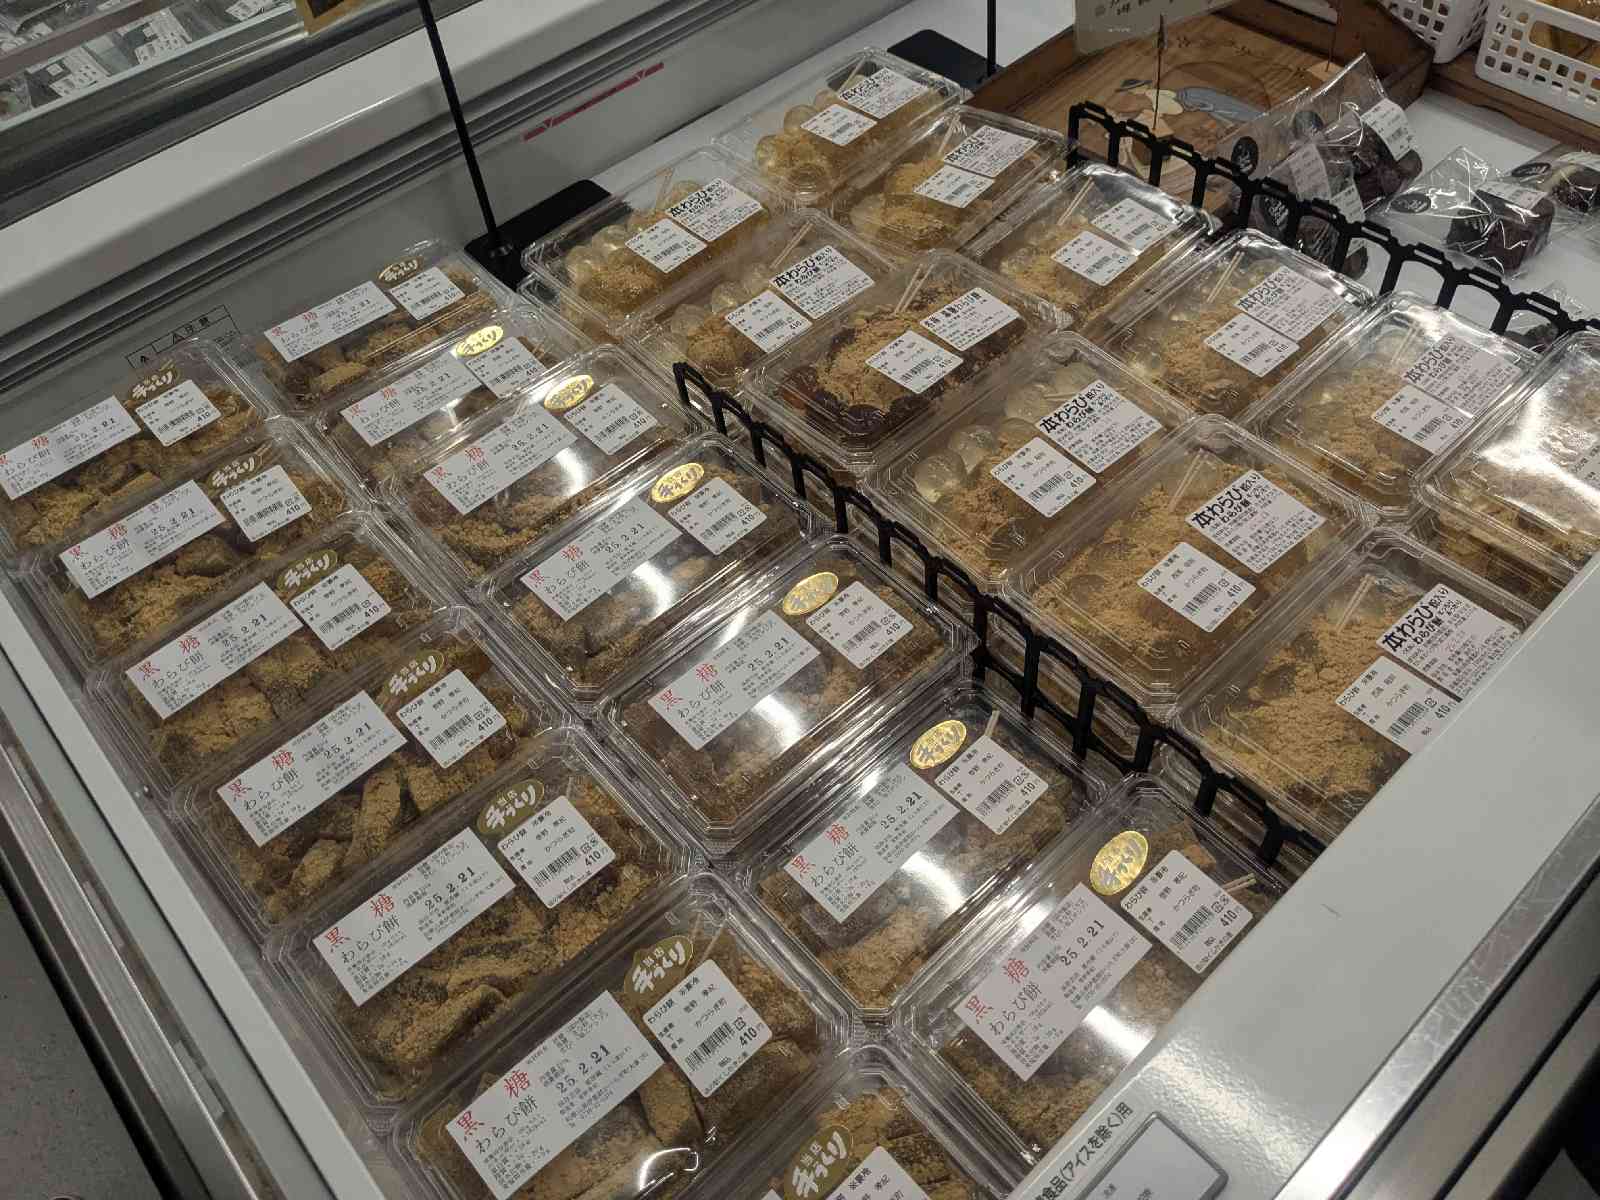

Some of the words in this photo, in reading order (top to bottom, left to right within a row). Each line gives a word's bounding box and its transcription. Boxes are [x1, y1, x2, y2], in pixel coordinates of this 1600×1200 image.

[212, 457, 254, 487] 手づくり
[284, 551, 337, 587] 手づくり
[389, 655, 436, 695] 手づくり
[244, 768, 299, 812] わらび餅
[486, 785, 536, 829] 手づくり
[810, 841, 859, 888] わらび餅
[324, 926, 351, 953] 黒
[370, 893, 394, 918] 糖
[341, 914, 400, 964] わらび餅
[632, 941, 692, 993] 手づくり
[641, 945, 666, 969] 当店
[965, 995, 994, 1024] 黒
[989, 981, 1042, 1036] わらび餅
[455, 1109, 485, 1141] 黒
[503, 1069, 530, 1098] 糖
[475, 1094, 538, 1154] わらび餅
[792, 1131, 851, 1198] 手づくり
[1034, 1101, 1134, 1200] 食品(アイスを除く)用
